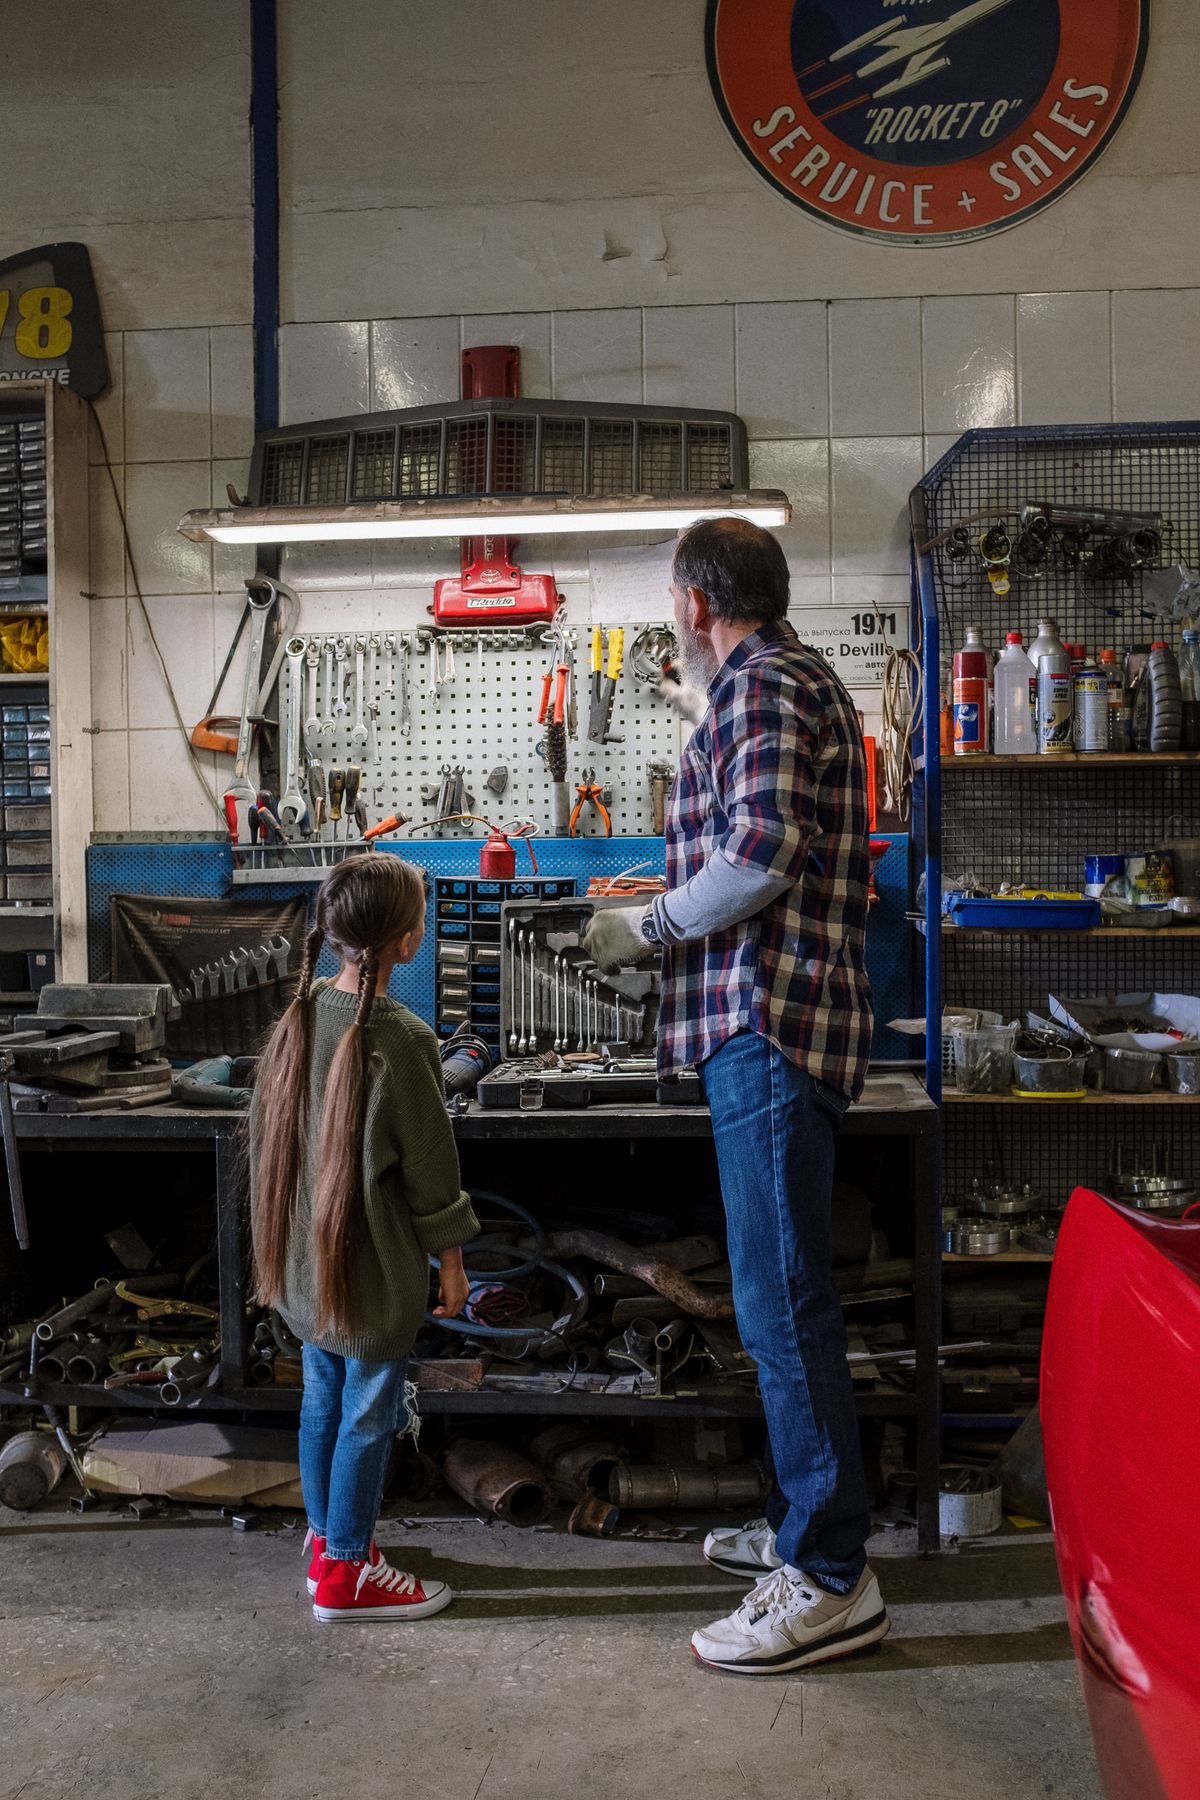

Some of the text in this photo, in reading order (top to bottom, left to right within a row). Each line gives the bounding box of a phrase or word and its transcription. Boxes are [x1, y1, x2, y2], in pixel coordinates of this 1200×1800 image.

[989, 77, 1109, 202] SALES
[811, 628, 850, 638] выпуска
[851, 613, 896, 635] 1971
[840, 643, 894, 656] Deville
